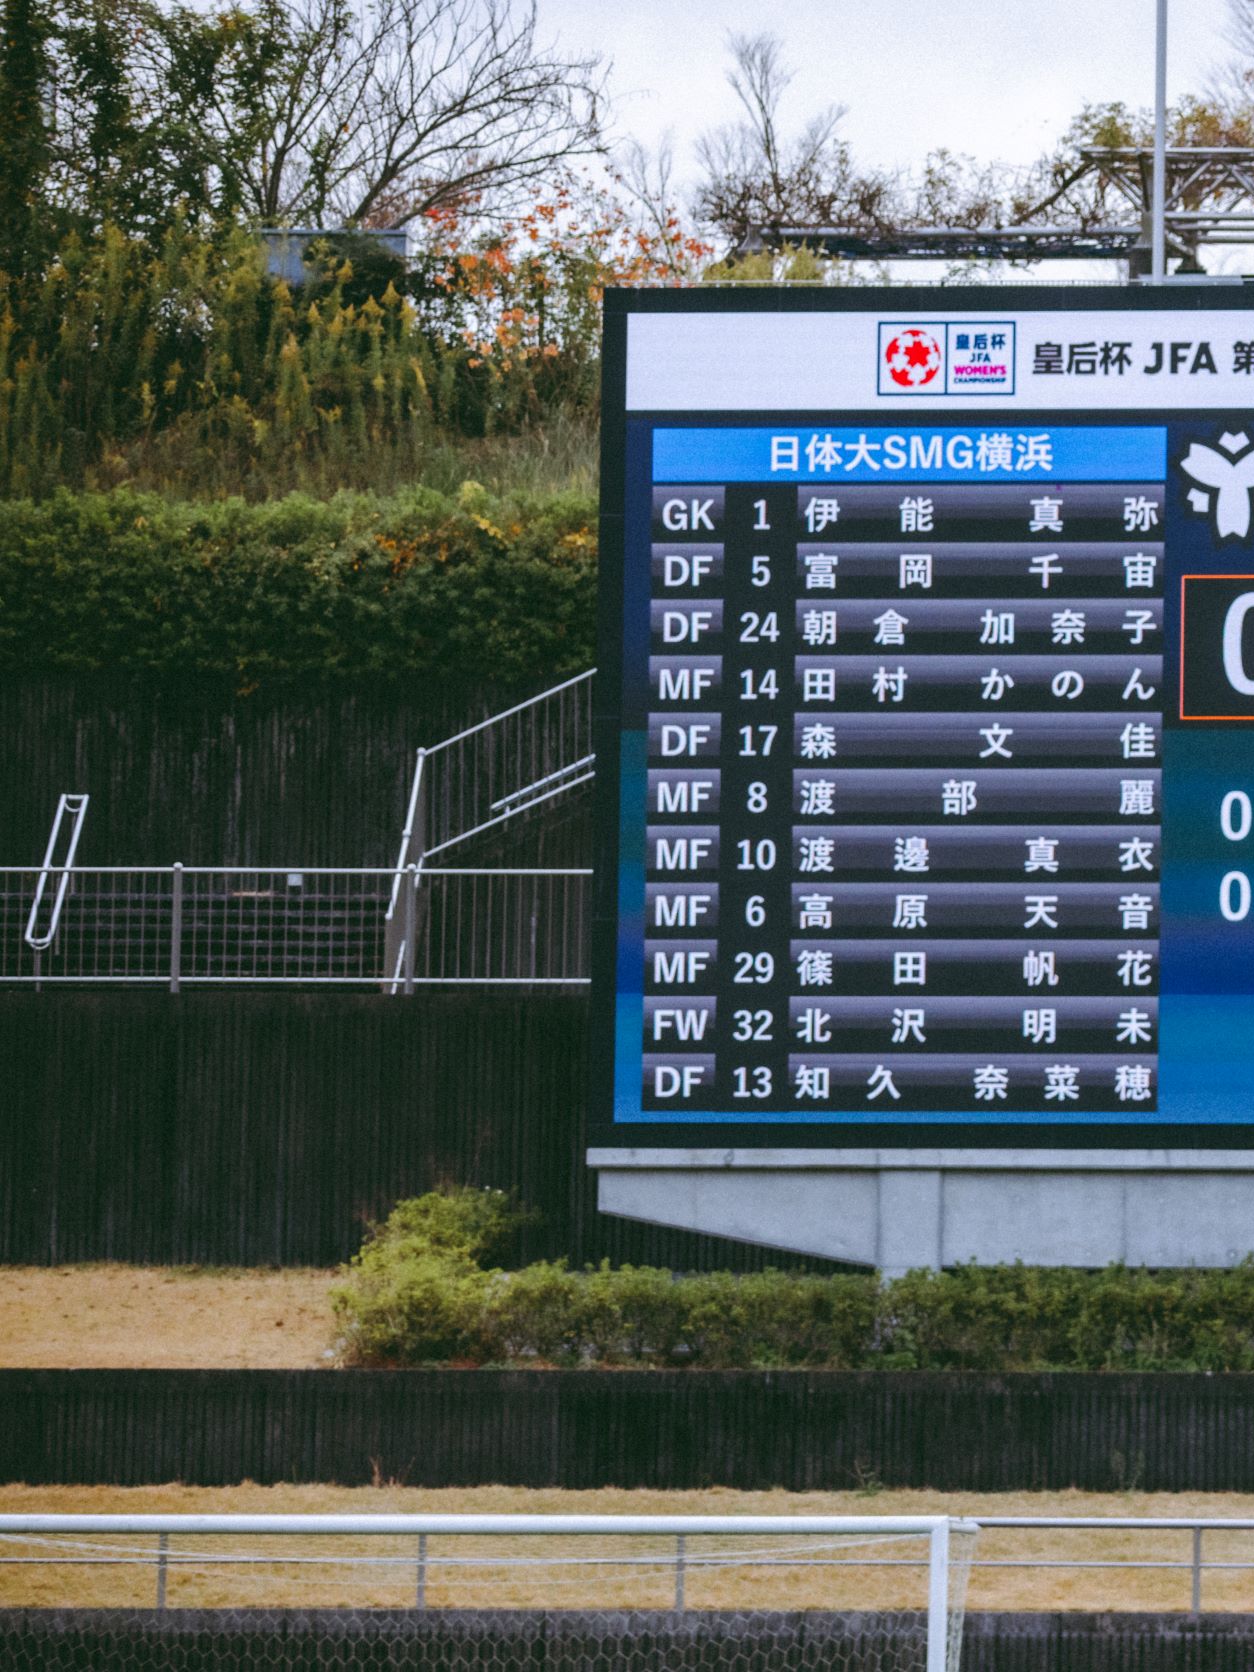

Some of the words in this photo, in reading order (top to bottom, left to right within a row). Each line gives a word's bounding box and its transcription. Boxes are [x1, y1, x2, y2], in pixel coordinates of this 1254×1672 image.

[956, 333, 1006, 350] 皇后杯
[954, 365, 1007, 375] WOMEN'S
[969, 353, 991, 363] JFA
[1032, 341, 1133, 376] 皇后杯
[1143, 341, 1219, 376] JFA
[769, 432, 1054, 473] 日体大SMG横浜
[662, 498, 715, 531] GK
[753, 499, 771, 530] 1
[664, 555, 714, 586] DF
[751, 556, 771, 587] 5
[663, 611, 713, 643] DF
[740, 612, 780, 643] 24
[659, 668, 715, 700] MF
[740, 669, 779, 700] 14
[661, 724, 711, 756] DF
[739, 725, 778, 756] 17
[657, 781, 713, 813] MF
[747, 781, 767, 813] 8
[1220, 790, 1252, 841] 0
[656, 838, 712, 870] MF
[737, 839, 776, 870] 10
[655, 895, 711, 926] MF
[746, 895, 765, 927] 6
[1219, 870, 1251, 922] 0
[654, 951, 710, 983] MF
[734, 952, 774, 984] 29
[654, 1009, 709, 1041] FW
[733, 1009, 773, 1041] 32
[655, 1065, 705, 1097] DF
[733, 1066, 772, 1098] 13
